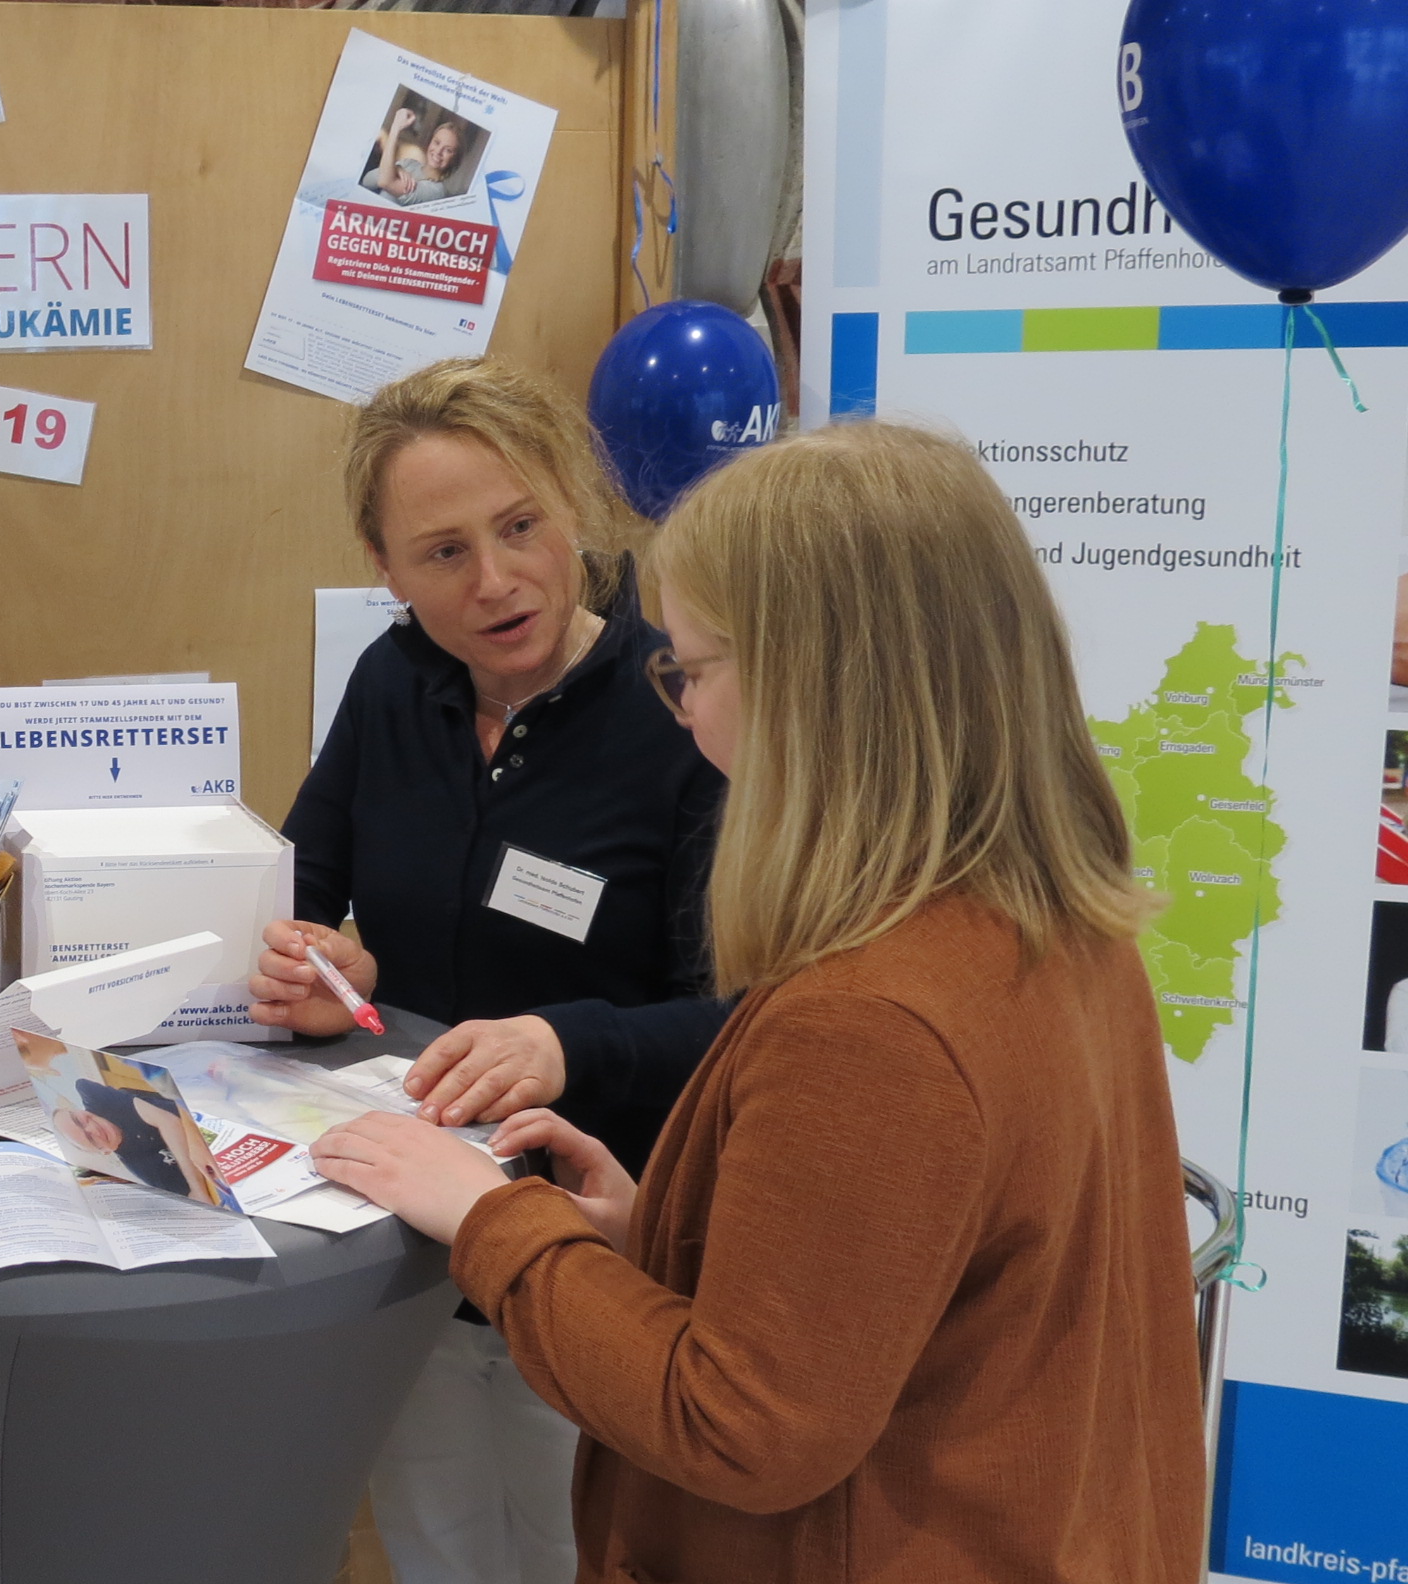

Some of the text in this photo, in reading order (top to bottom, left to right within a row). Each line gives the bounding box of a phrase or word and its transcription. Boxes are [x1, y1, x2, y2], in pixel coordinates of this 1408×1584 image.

[1121, 42, 1143, 112] B
[929, 181, 1171, 241] Gesundh
[328, 204, 488, 254] ÄRMEL HOCH
[326, 233, 482, 272] GEGEN BLUTKREBS!
[927, 259, 958, 275] am
[967, 252, 1097, 275] Landratsamt
[327, 254, 475, 285] Registriere Dich als Stammzellspender
[341, 268, 458, 294] mit Deinem LEBENSRETTERSET!
[737, 402, 781, 443] AK
[973, 440, 1129, 463] ktionsschutz
[1009, 491, 1206, 520] ngerenberatung
[1036, 542, 1302, 572] nd Jugendgesundheit
[1238, 675, 1325, 688] Müncsmünster
[14, 701, 32, 709] BIST
[34, 700, 77, 708] ZWISCHEN
[123, 699, 148, 707] JAHRE
[150, 698, 165, 706] ALT
[188, 697, 225, 705] GESUND?
[25, 717, 53, 725] WERDE
[55, 716, 77, 725] JETZT
[80, 715, 165, 724] STAMMZELLSPENDER
[167, 714, 182, 722] MIT
[0, 726, 229, 749] LEBENSRETTERSET
[202, 780, 235, 794] AKB
[51, 942, 130, 952] BENSRETTERSET
[51, 952, 116, 962] AMMZELL
[88, 965, 171, 994] BITTE VORSICHTIG ÖFFNEN!
[179, 1004, 249, 1015] www.akb.de
[1162, 992, 1248, 1009] Schweitenkirche
[221, 1138, 261, 1161] HOCH
[1237, 1190, 1308, 1219] atung
[1245, 1535, 1408, 1584] landkreis-pfa
